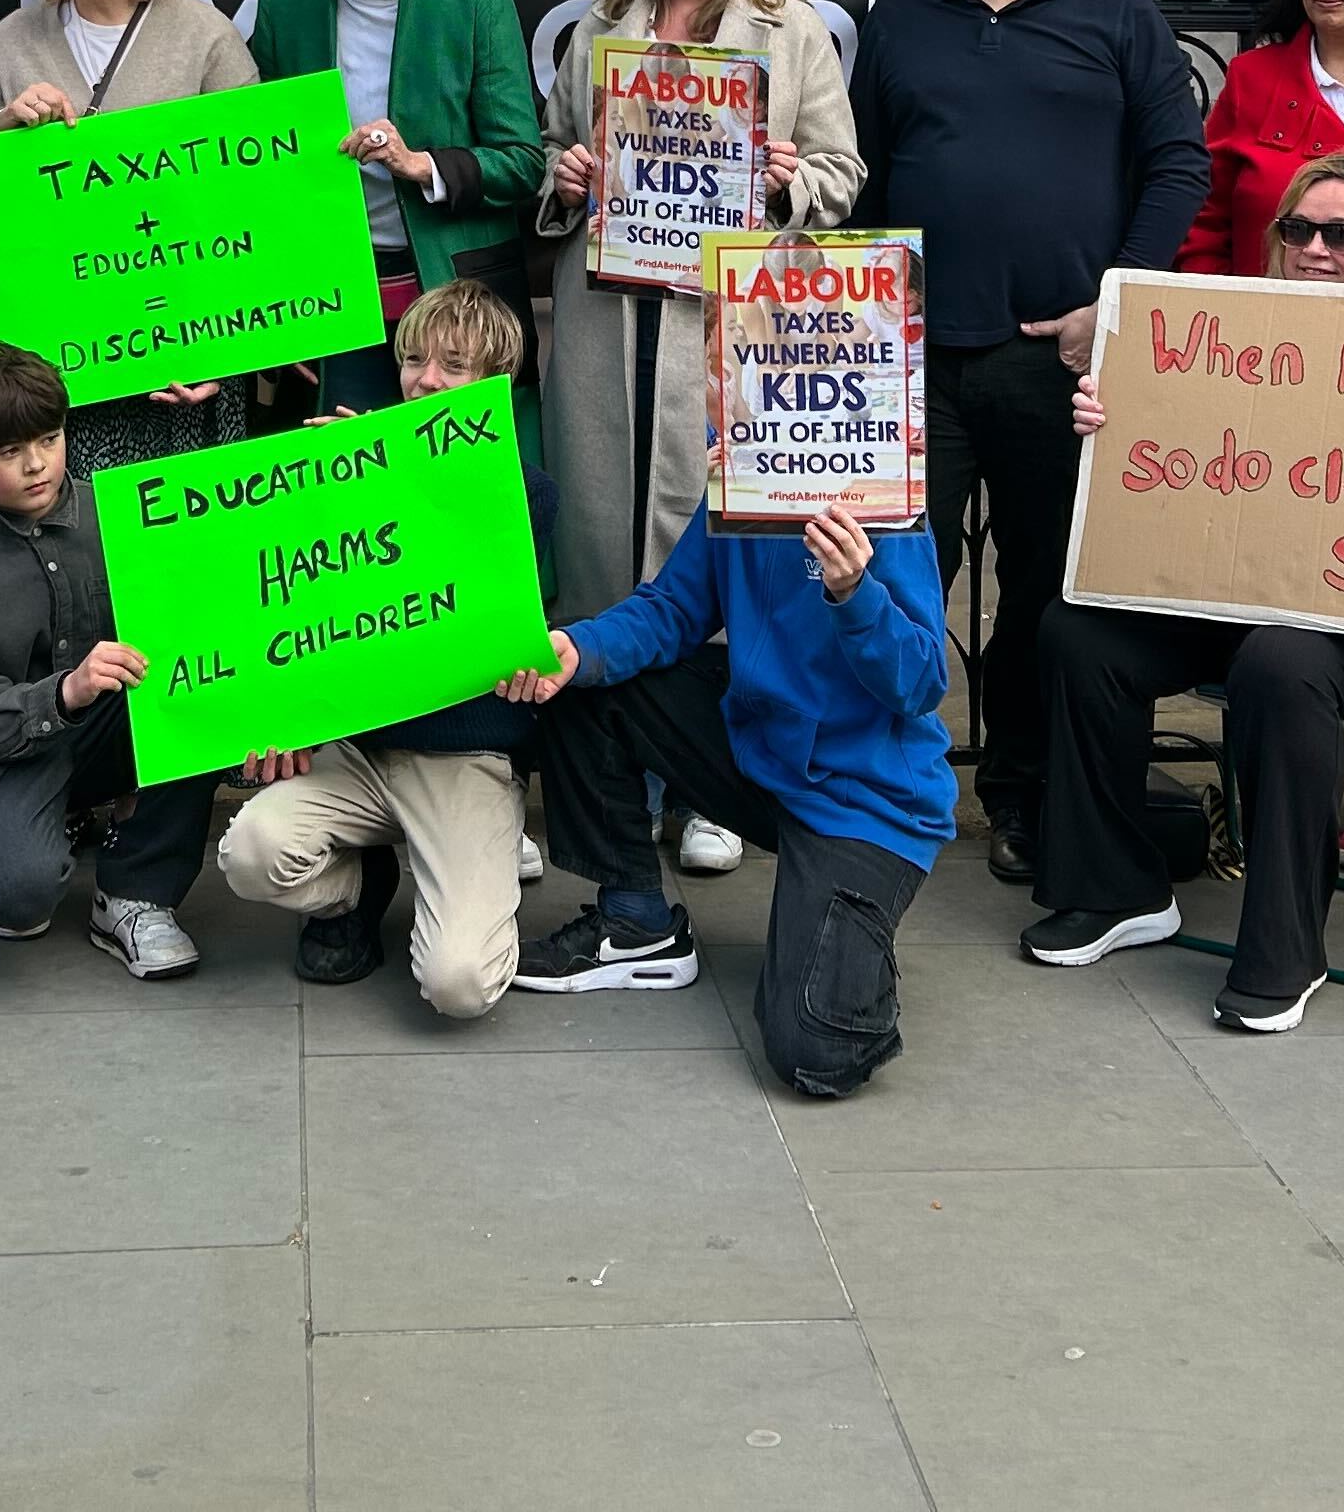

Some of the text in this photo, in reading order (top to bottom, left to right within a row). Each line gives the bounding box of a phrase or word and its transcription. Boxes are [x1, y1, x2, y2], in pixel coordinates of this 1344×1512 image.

[610, 67, 750, 110] LABOUR
[645, 107, 712, 132] TAXES
[37, 126, 301, 201] TAXATION
[615, 131, 743, 162] VULNERABLE
[635, 159, 719, 199] KIDS
[608, 196, 744, 229] OUT OF THEIR
[72, 229, 254, 281] EDUCATION
[626, 224, 700, 250] SCHOO
[726, 266, 897, 303] LABOUR
[58, 288, 343, 374] DISCRIMINATION
[772, 311, 854, 335] TAXES
[732, 341, 895, 365] VULNERABLE
[1150, 308, 1305, 387] When
[762, 372, 868, 412] KIDS
[730, 420, 900, 444] OUT OF THEIR
[137, 406, 501, 530] EDUCATION TAX
[755, 451, 876, 475] SCHOOLS
[256, 521, 403, 608] HARMS
[167, 581, 458, 697] ALL CHILDREN
